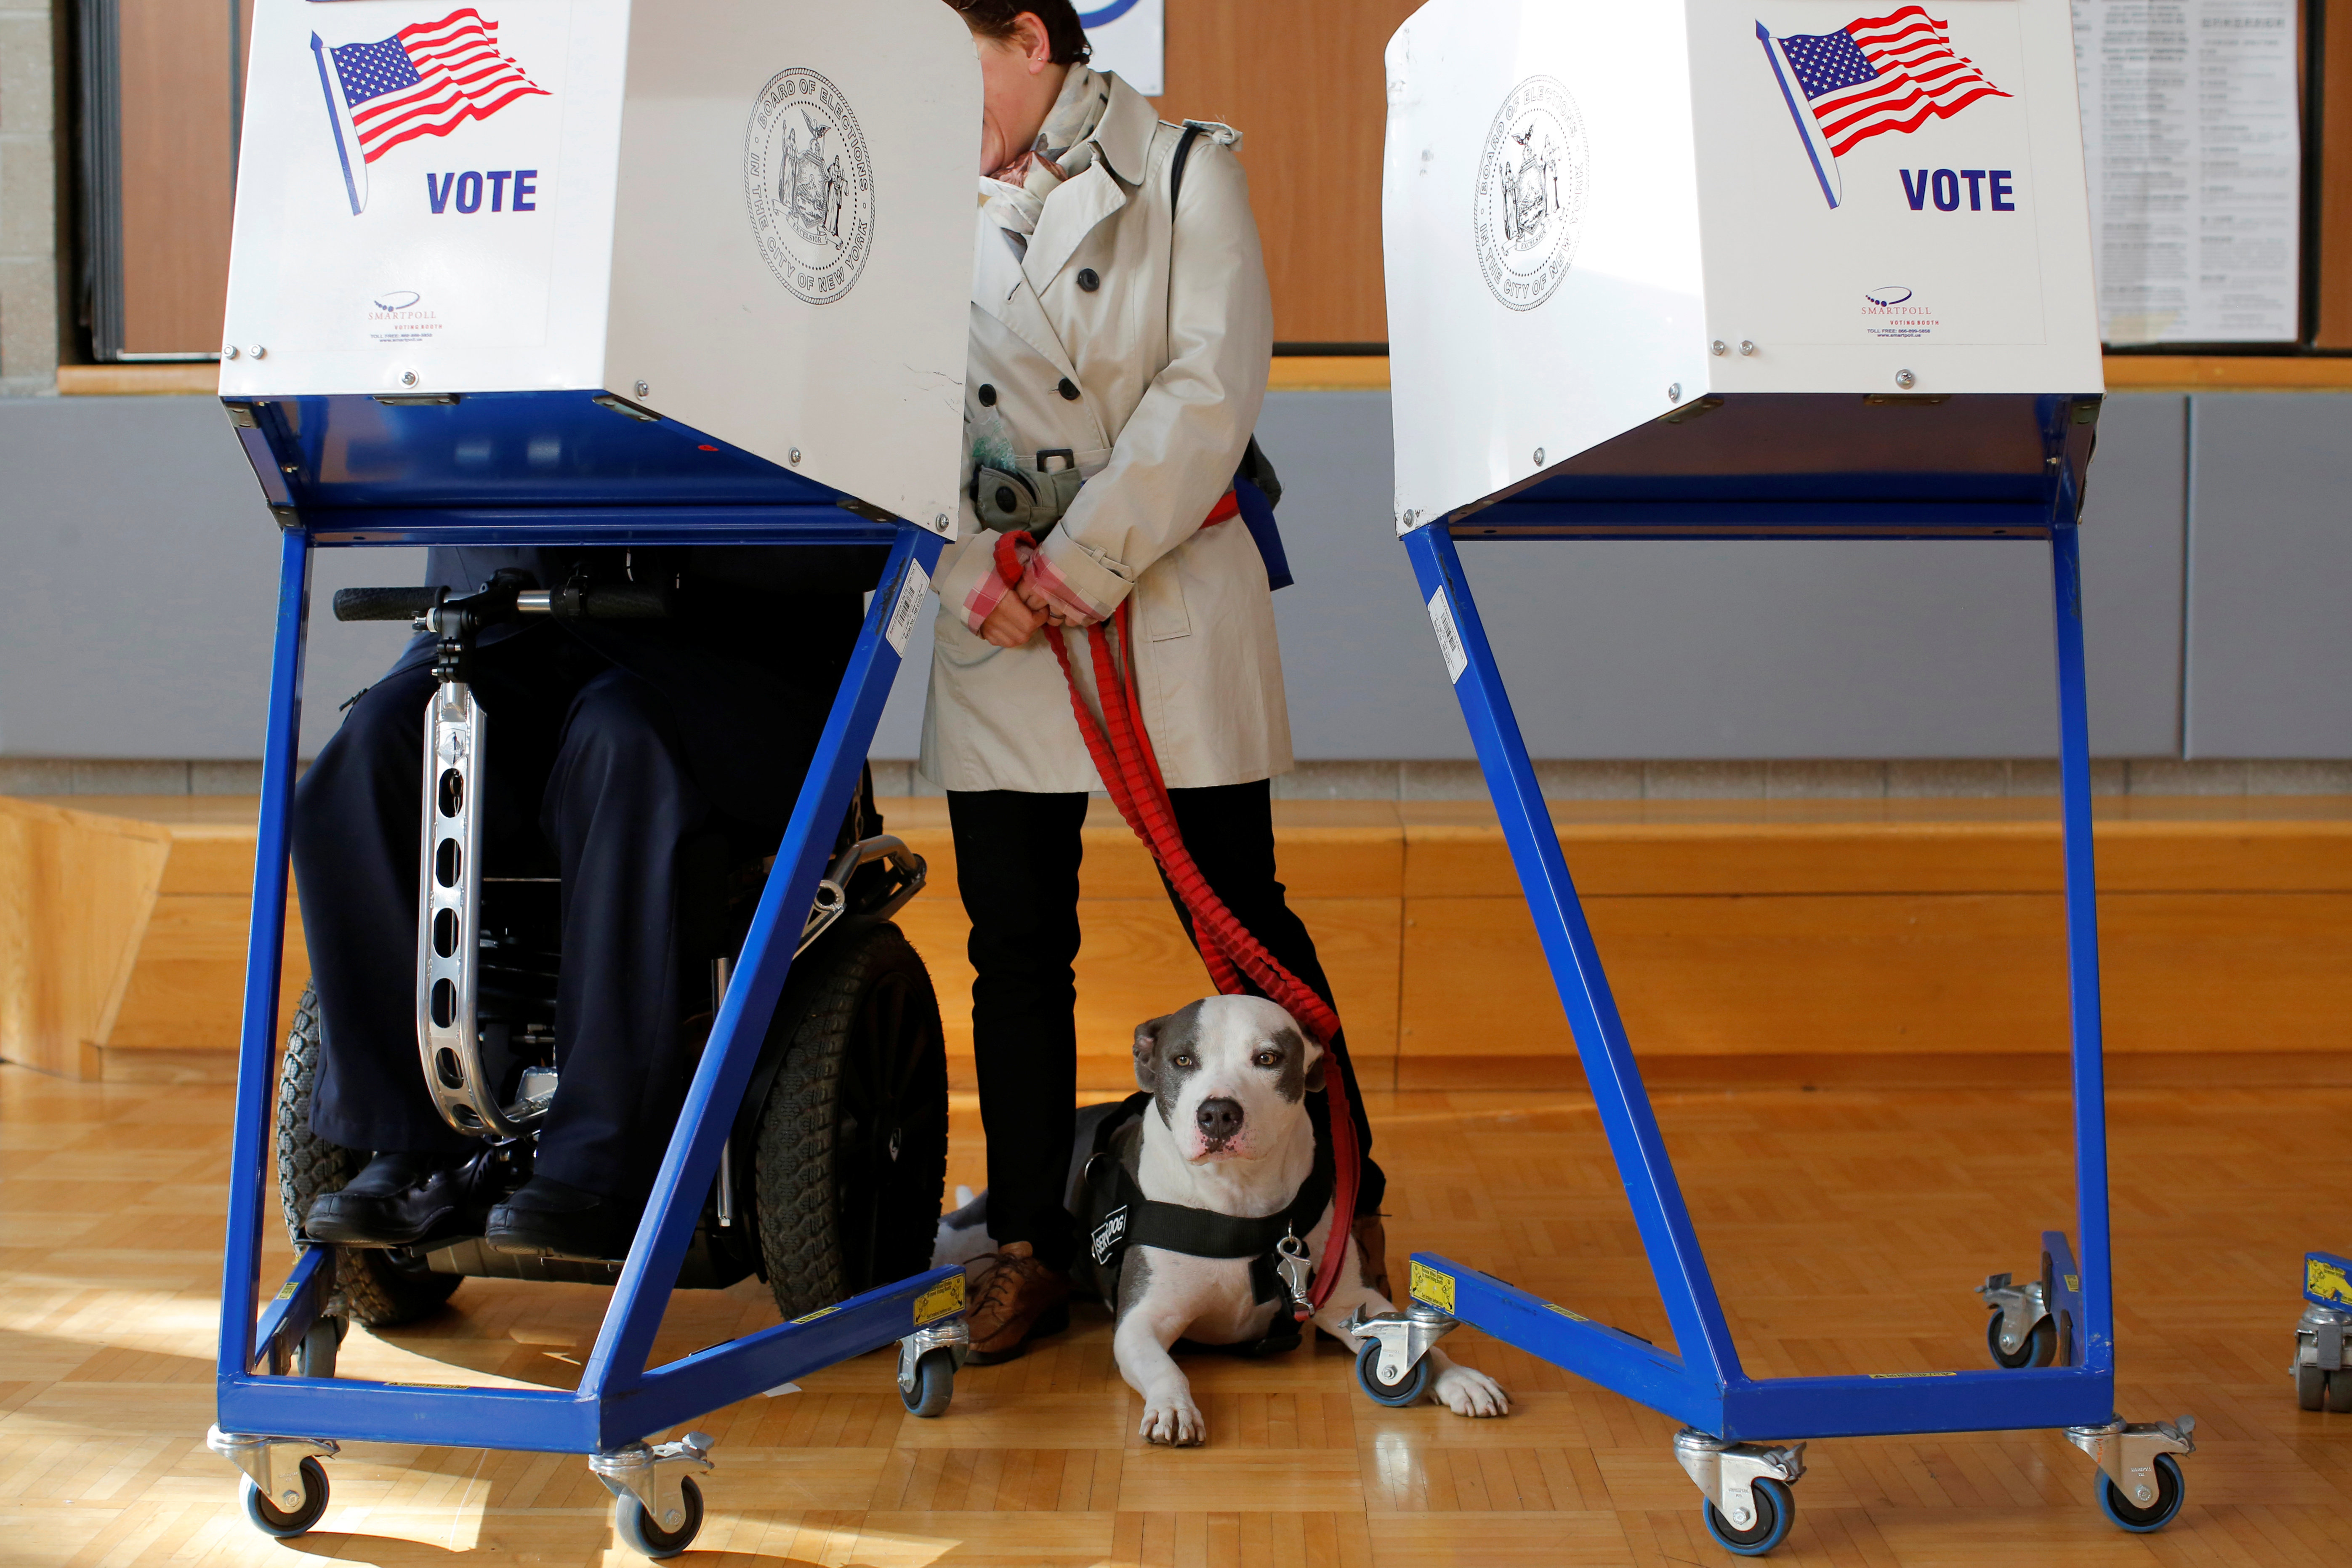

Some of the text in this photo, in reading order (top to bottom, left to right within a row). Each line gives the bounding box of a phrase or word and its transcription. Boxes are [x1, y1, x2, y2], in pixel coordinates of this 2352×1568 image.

[758, 79, 868, 191] BOARD OF ELECTIONS
[1480, 86, 1577, 194] BOARD OF ELECTIONS
[426, 170, 538, 215] VOTE
[1899, 169, 2015, 211] VOTE
[750, 153, 867, 292] IN THE CITY OF NEW YORK
[793, 222, 822, 243] EXCELSIOR
[1480, 162, 1583, 298] IN THE CITY OF NEW YORK
[1521, 229, 1547, 250] EXCELSIOR
[368, 311, 436, 320] SMARTPOLL
[1096, 1214, 1124, 1254] SERV DOG
